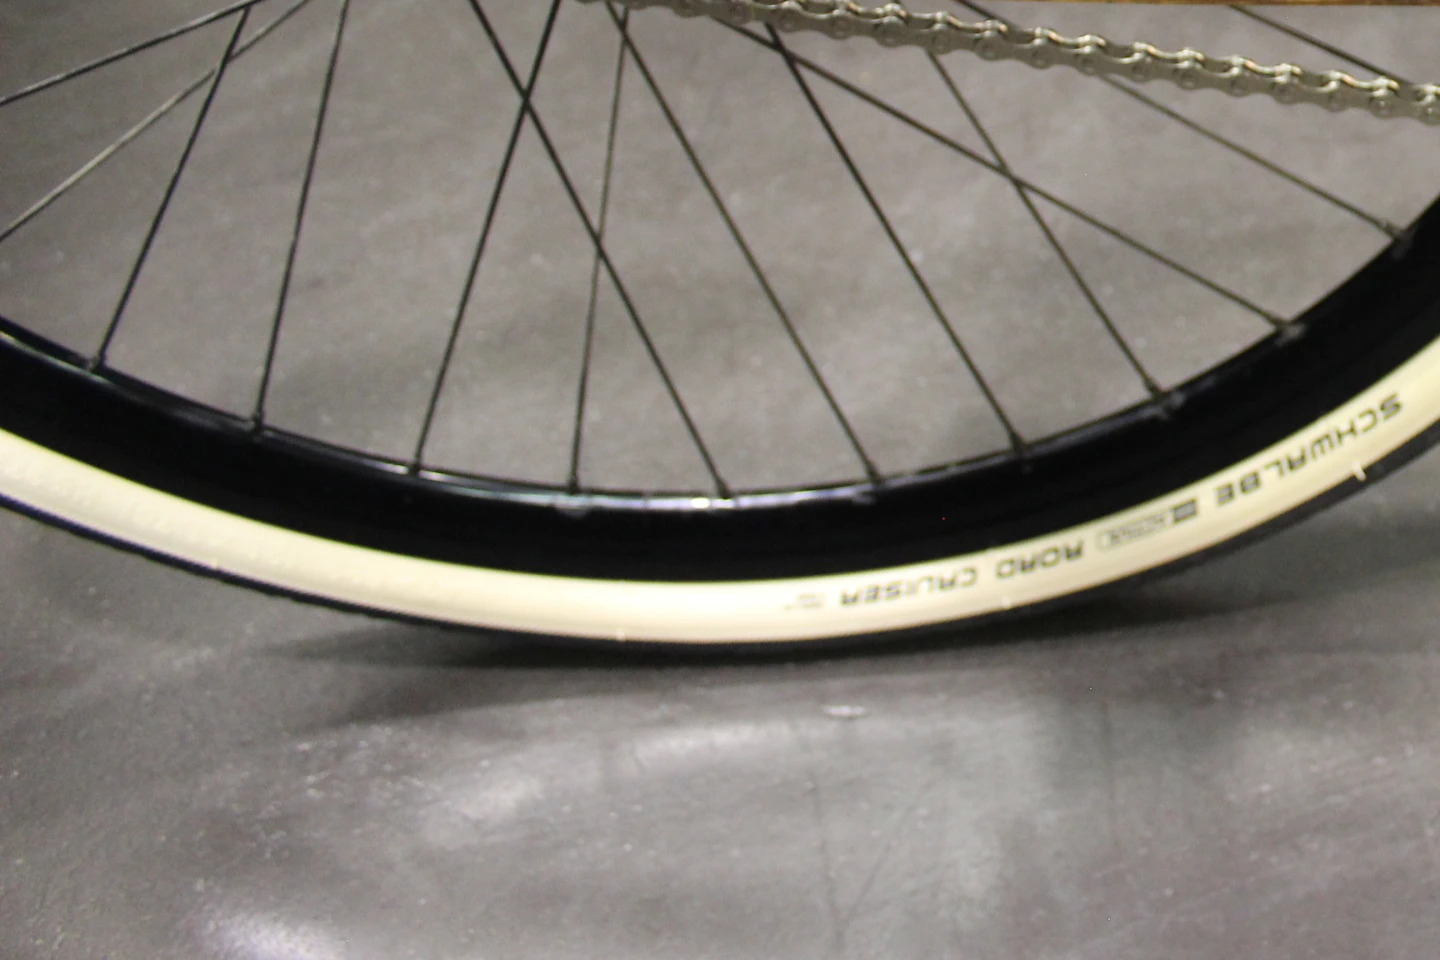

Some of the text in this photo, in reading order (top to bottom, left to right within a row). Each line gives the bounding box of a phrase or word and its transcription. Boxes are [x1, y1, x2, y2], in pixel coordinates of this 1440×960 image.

[1215, 392, 1404, 507] SCHWALBE
[994, 539, 1085, 580] ROAD
[840, 566, 978, 606] CRUISER
